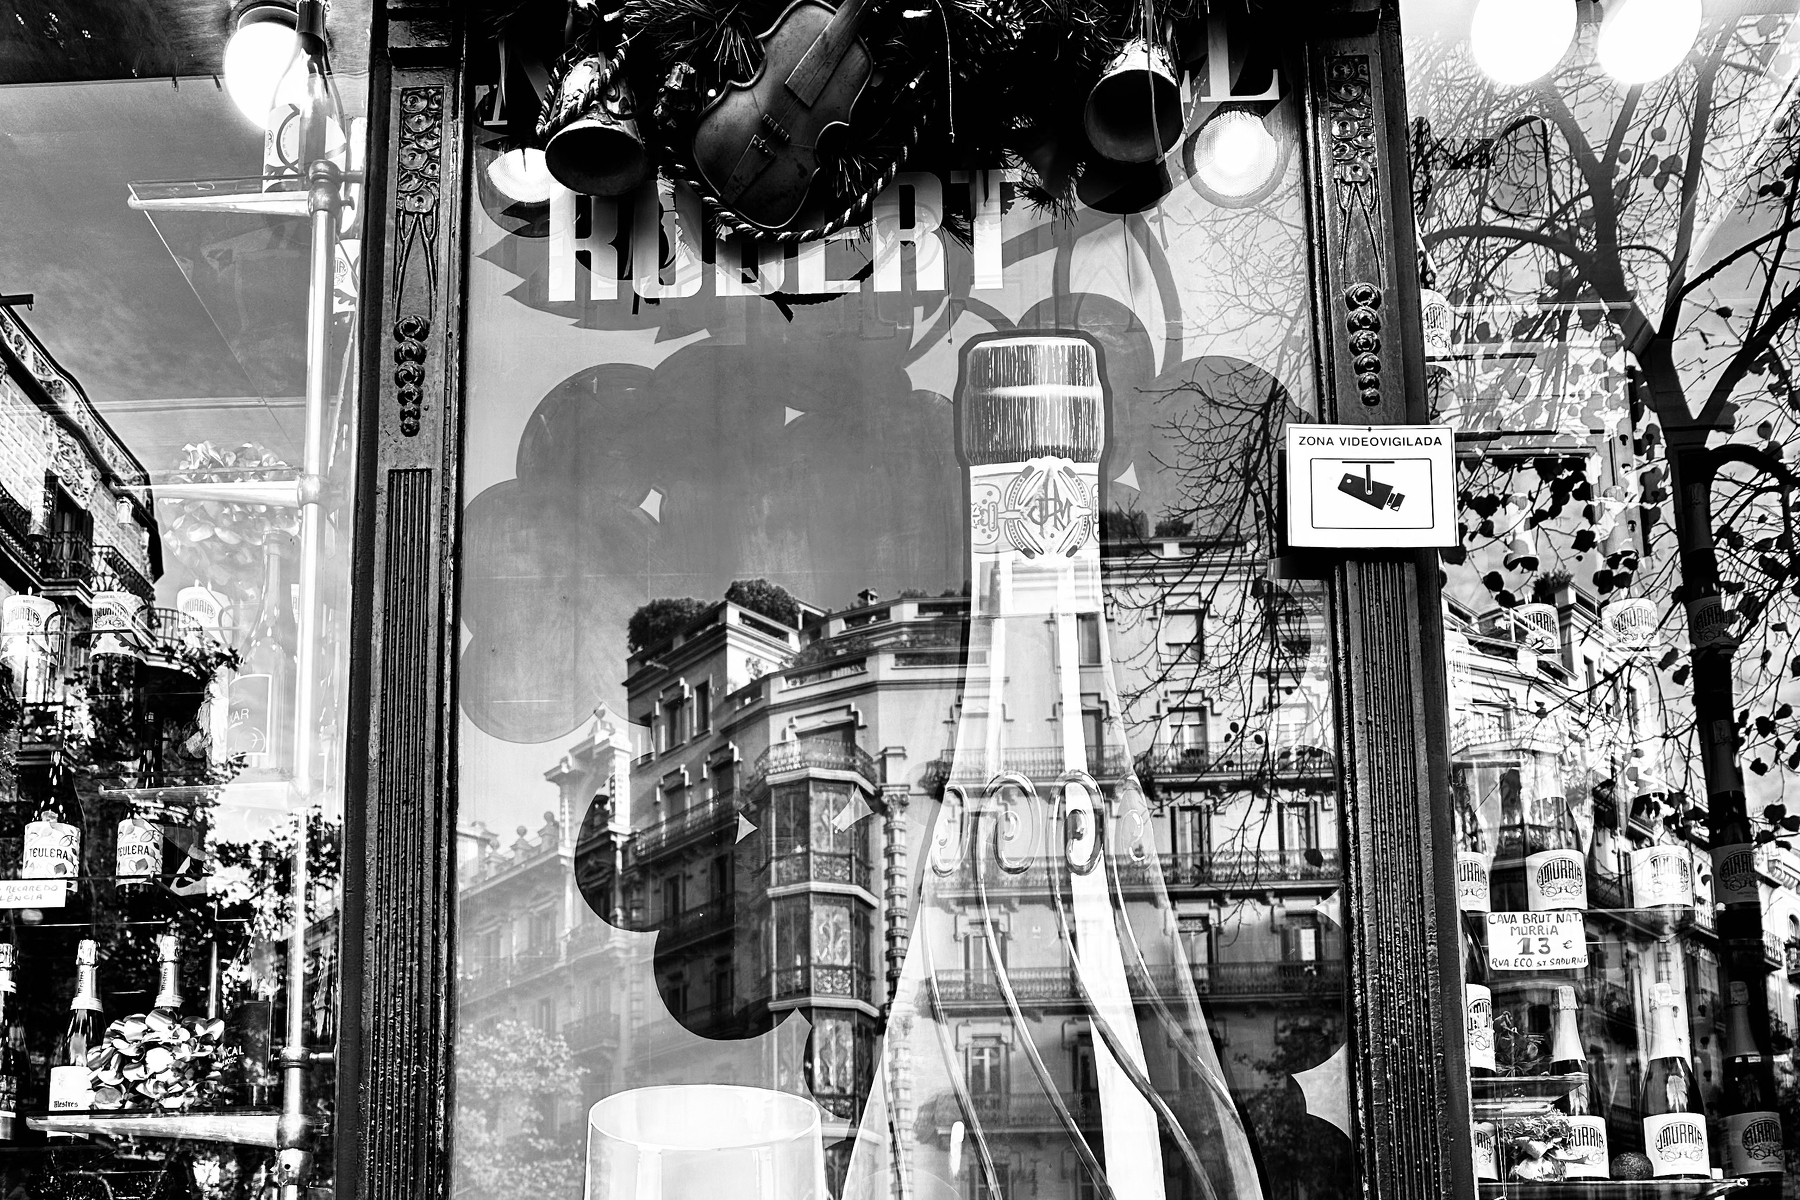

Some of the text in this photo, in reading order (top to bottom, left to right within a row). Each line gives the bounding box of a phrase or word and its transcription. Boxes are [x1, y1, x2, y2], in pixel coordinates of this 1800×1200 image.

[1299, 436, 1443, 447] ZONA VIDEOVIGILADA
[29, 847, 68, 859] TEULERA
[1488, 914, 1517, 925] CAVA
[1522, 914, 1551, 925] BRUT
[1517, 937, 1551, 956] 13
